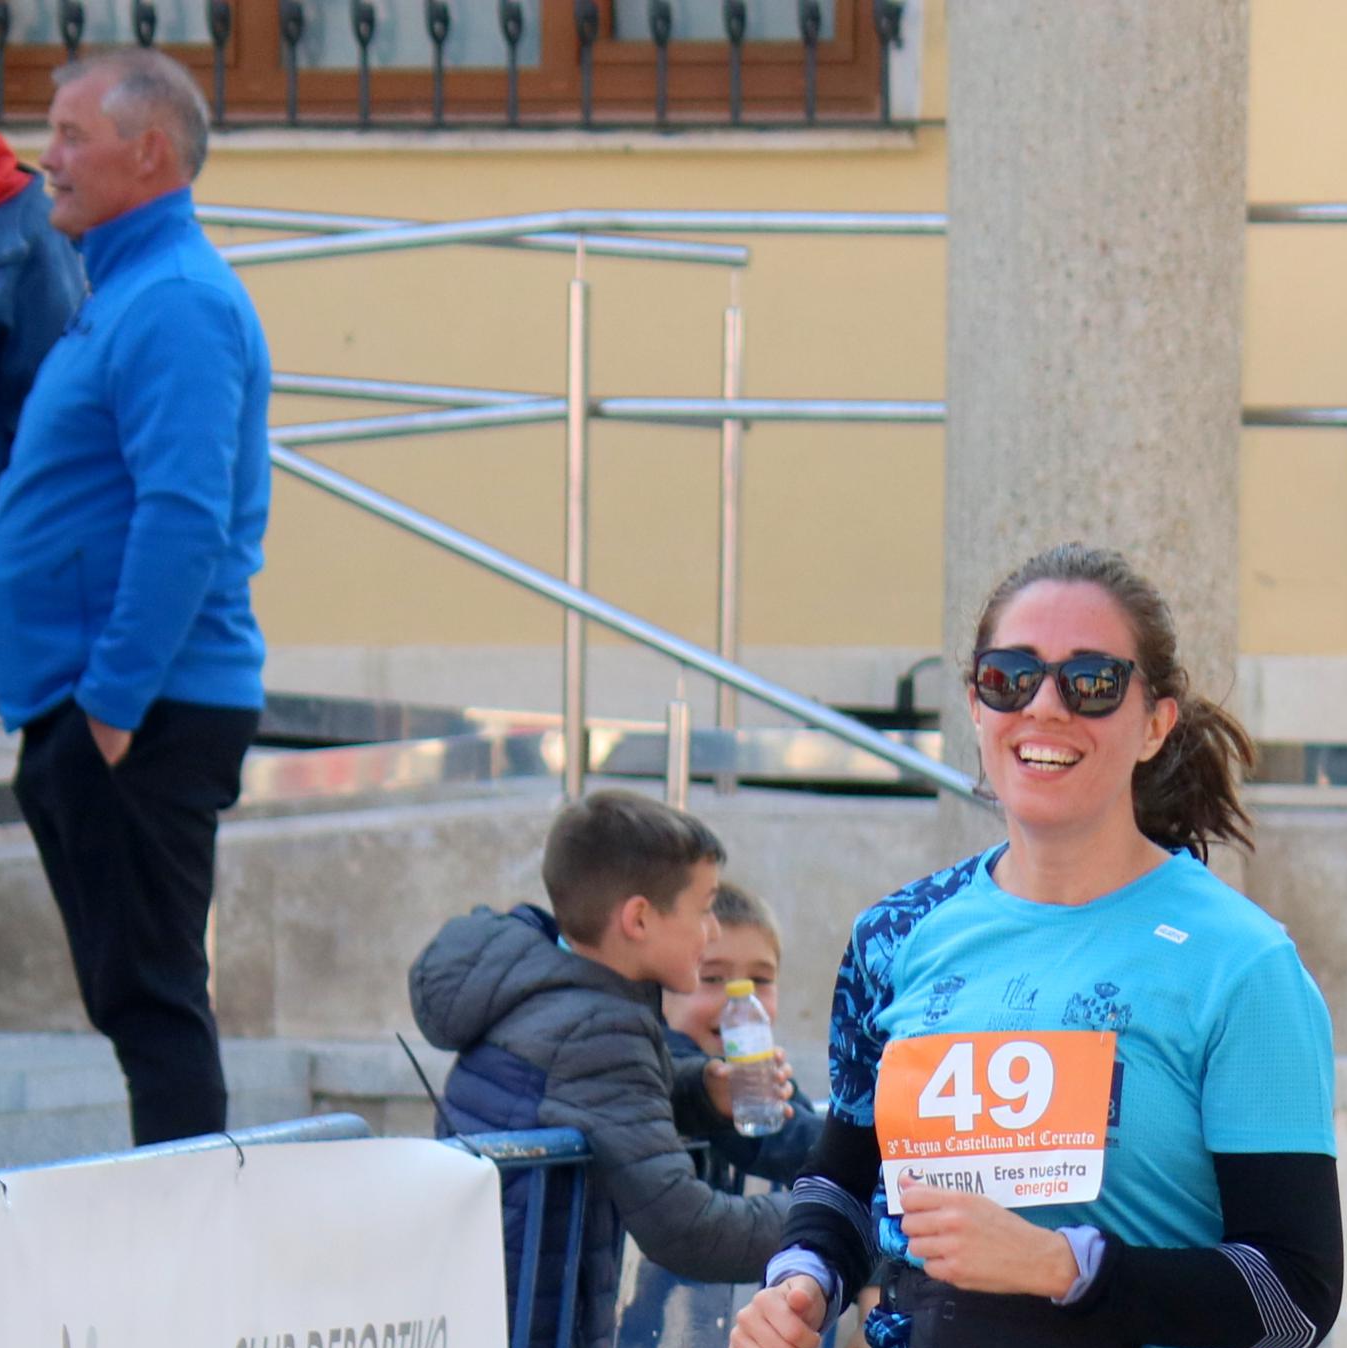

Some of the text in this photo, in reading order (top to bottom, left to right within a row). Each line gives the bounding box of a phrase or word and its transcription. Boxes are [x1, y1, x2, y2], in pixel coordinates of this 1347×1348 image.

[918, 1041, 1055, 1132] 49
[945, 1133, 1013, 1152] Castellana
[1017, 1132, 1035, 1147] del
[1040, 1129, 1095, 1146] Cerrato
[994, 1161, 1086, 1181] Eres nuestra
[1015, 1178, 1068, 1198] energía
